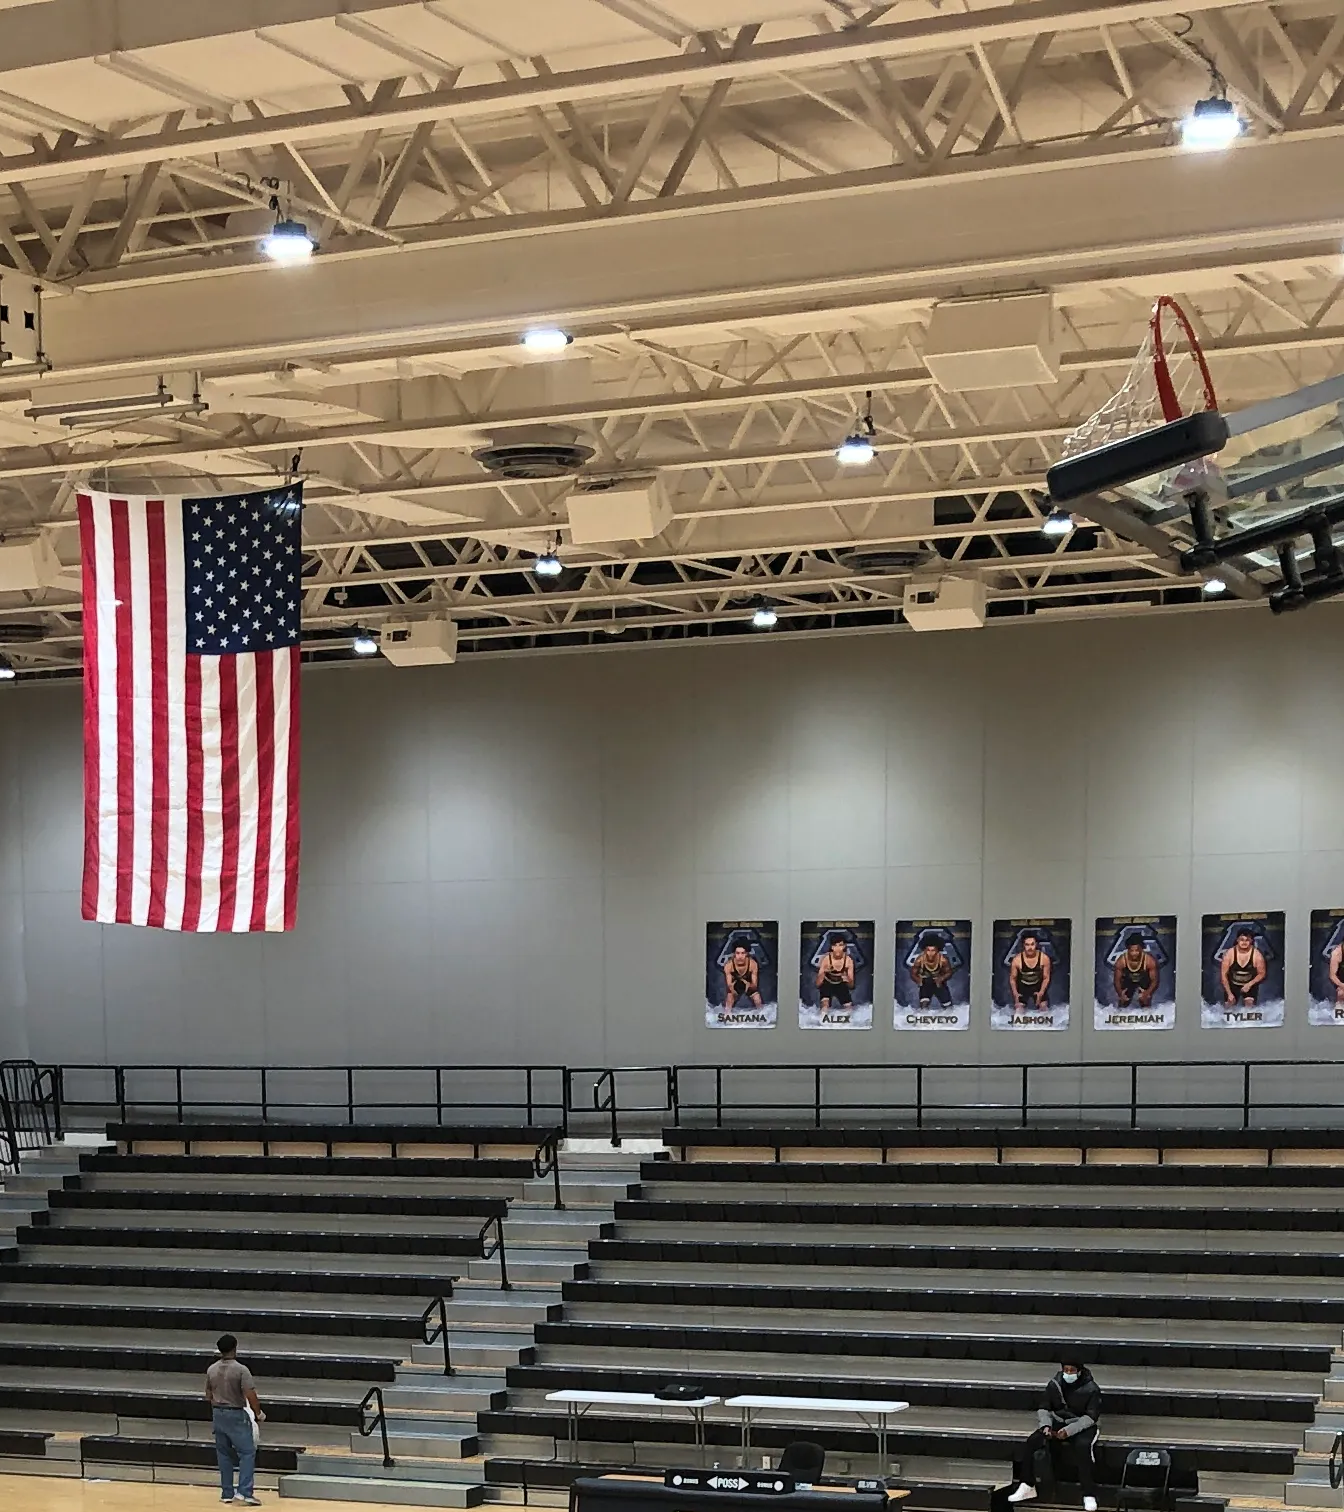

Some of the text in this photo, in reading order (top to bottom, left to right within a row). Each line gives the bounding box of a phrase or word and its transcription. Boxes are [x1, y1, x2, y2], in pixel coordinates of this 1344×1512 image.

[717, 1013, 767, 1023] SANTANA
[822, 1014, 850, 1024] ALEX
[906, 1014, 958, 1025] CHEVEYO
[1008, 1014, 1054, 1025] JASHON
[1105, 1014, 1164, 1024] JEREMIAH
[1223, 1012, 1262, 1022] TYLER
[718, 1477, 738, 1488] POSS
